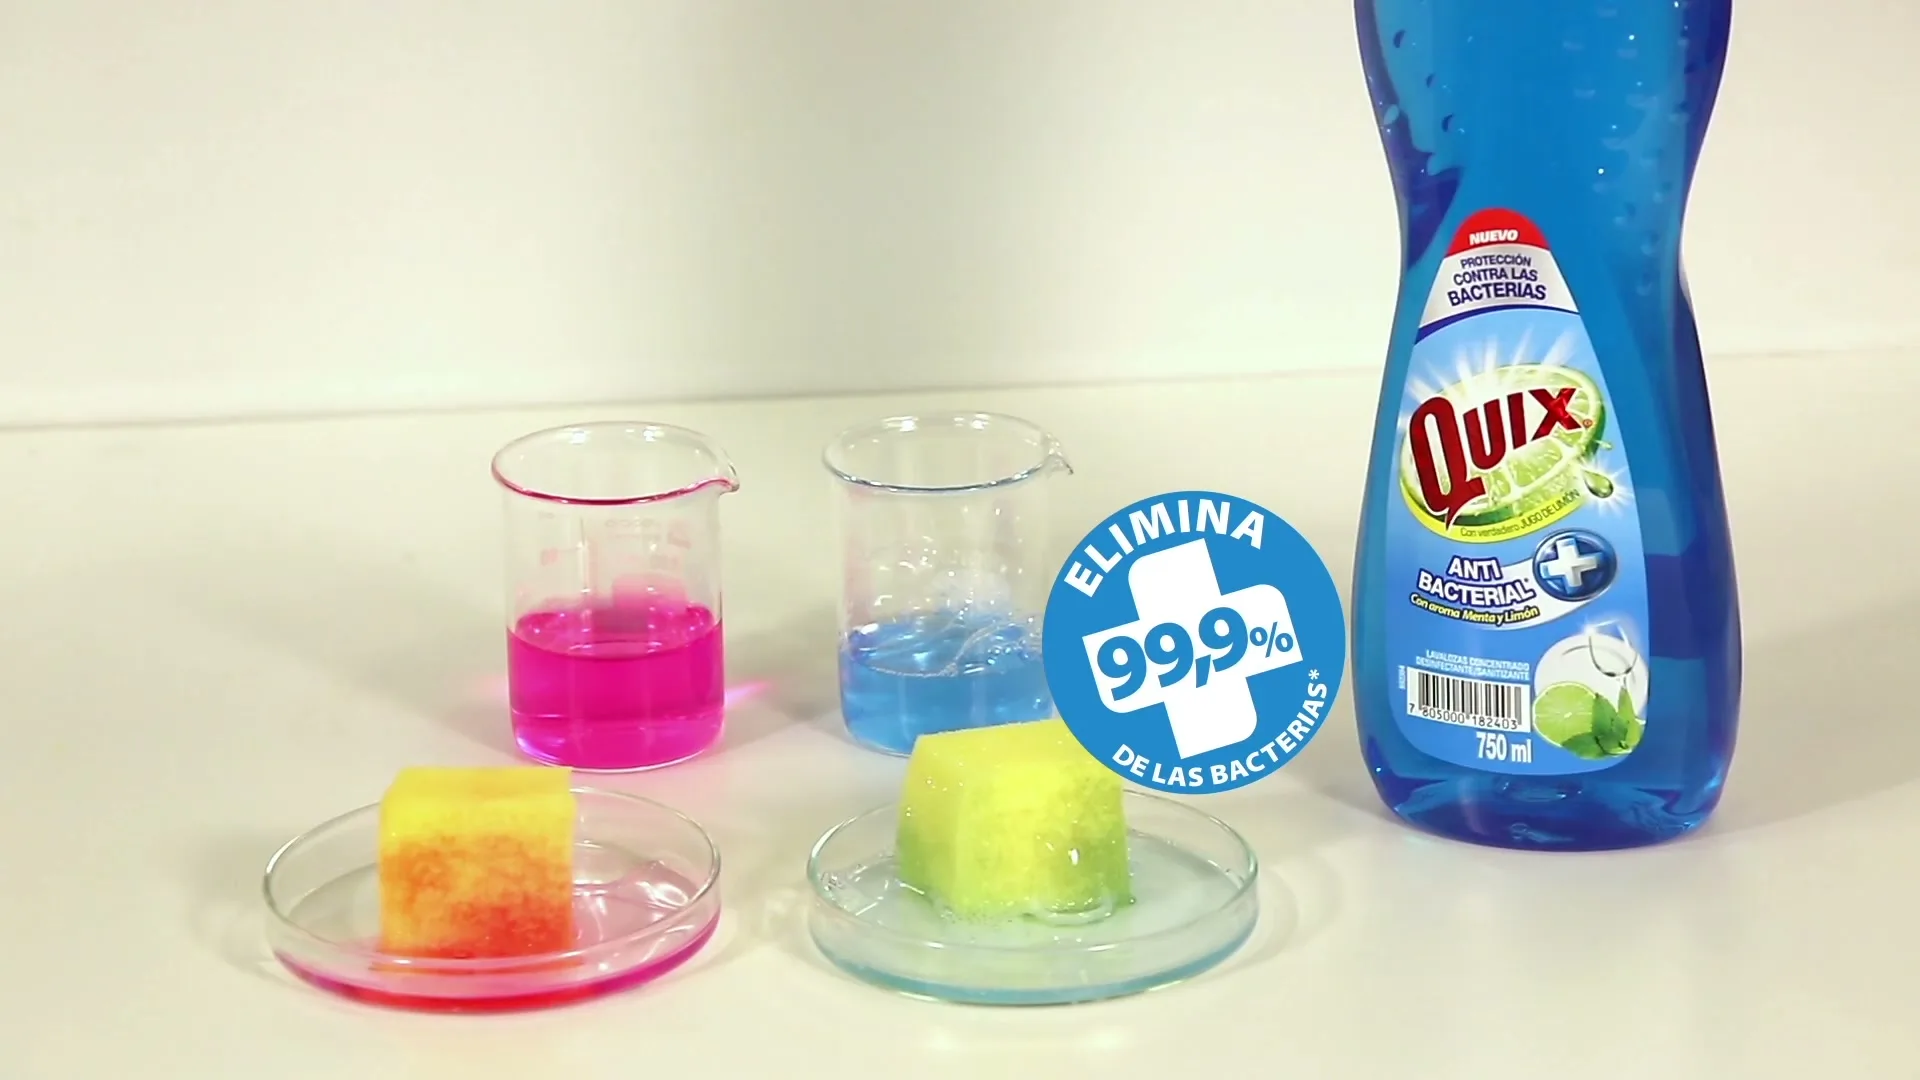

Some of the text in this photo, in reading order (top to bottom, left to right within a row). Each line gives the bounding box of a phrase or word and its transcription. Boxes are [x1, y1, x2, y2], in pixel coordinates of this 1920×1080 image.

[1469, 229, 1518, 245] NUEVO
[1460, 254, 1531, 269] PROTECCIÓN
[1453, 268, 1538, 286] CONTRA LAS
[1447, 282, 1546, 306] BACTERIAS
[1460, 489, 1580, 537] Con verdadero JUGO DE LIMÓN
[1447, 557, 1502, 580] ANTI
[1410, 594, 1539, 626] Con aroma Menta y Limón
[1409, 703, 1518, 730] 7 805000 182403
[1477, 732, 1532, 763] 750 ml
